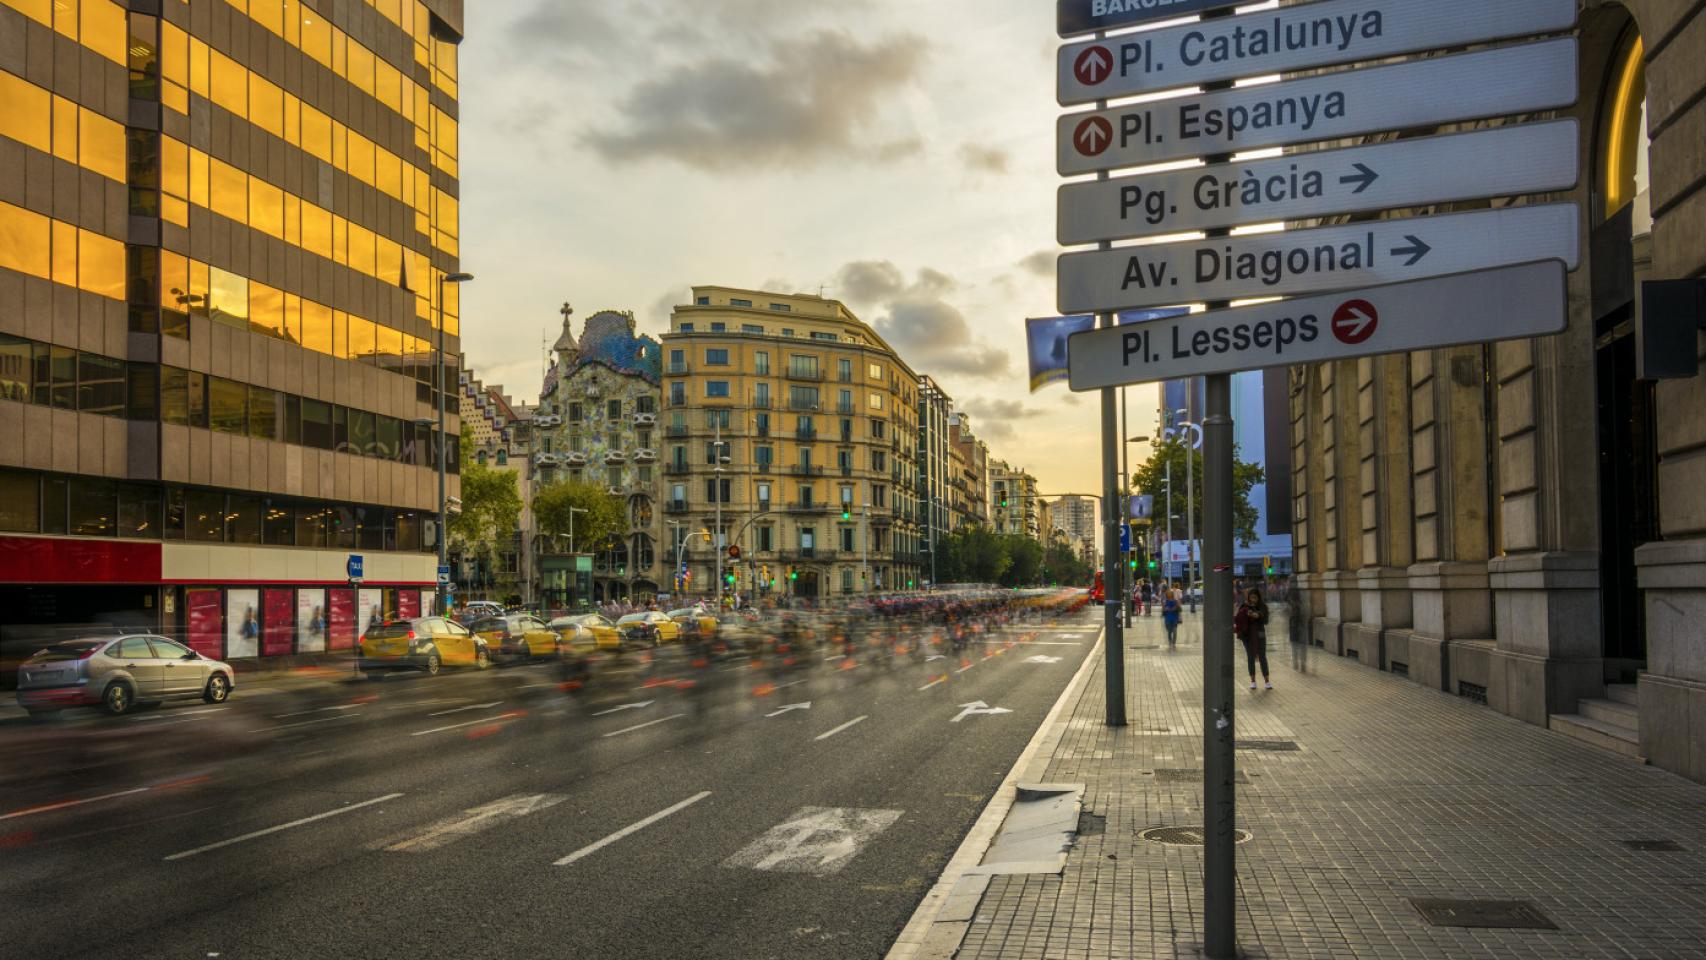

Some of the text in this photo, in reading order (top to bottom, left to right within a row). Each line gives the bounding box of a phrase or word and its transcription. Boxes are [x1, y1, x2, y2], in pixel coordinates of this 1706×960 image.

[1120, 10, 1382, 77] Pl. Catalunya
[1120, 91, 1345, 148] Pl. Espanya
[1120, 164, 1323, 225] Pg. Gràcia
[1121, 232, 1374, 290] Av. Diagonal
[1122, 315, 1319, 366] Pl. Lesseps
